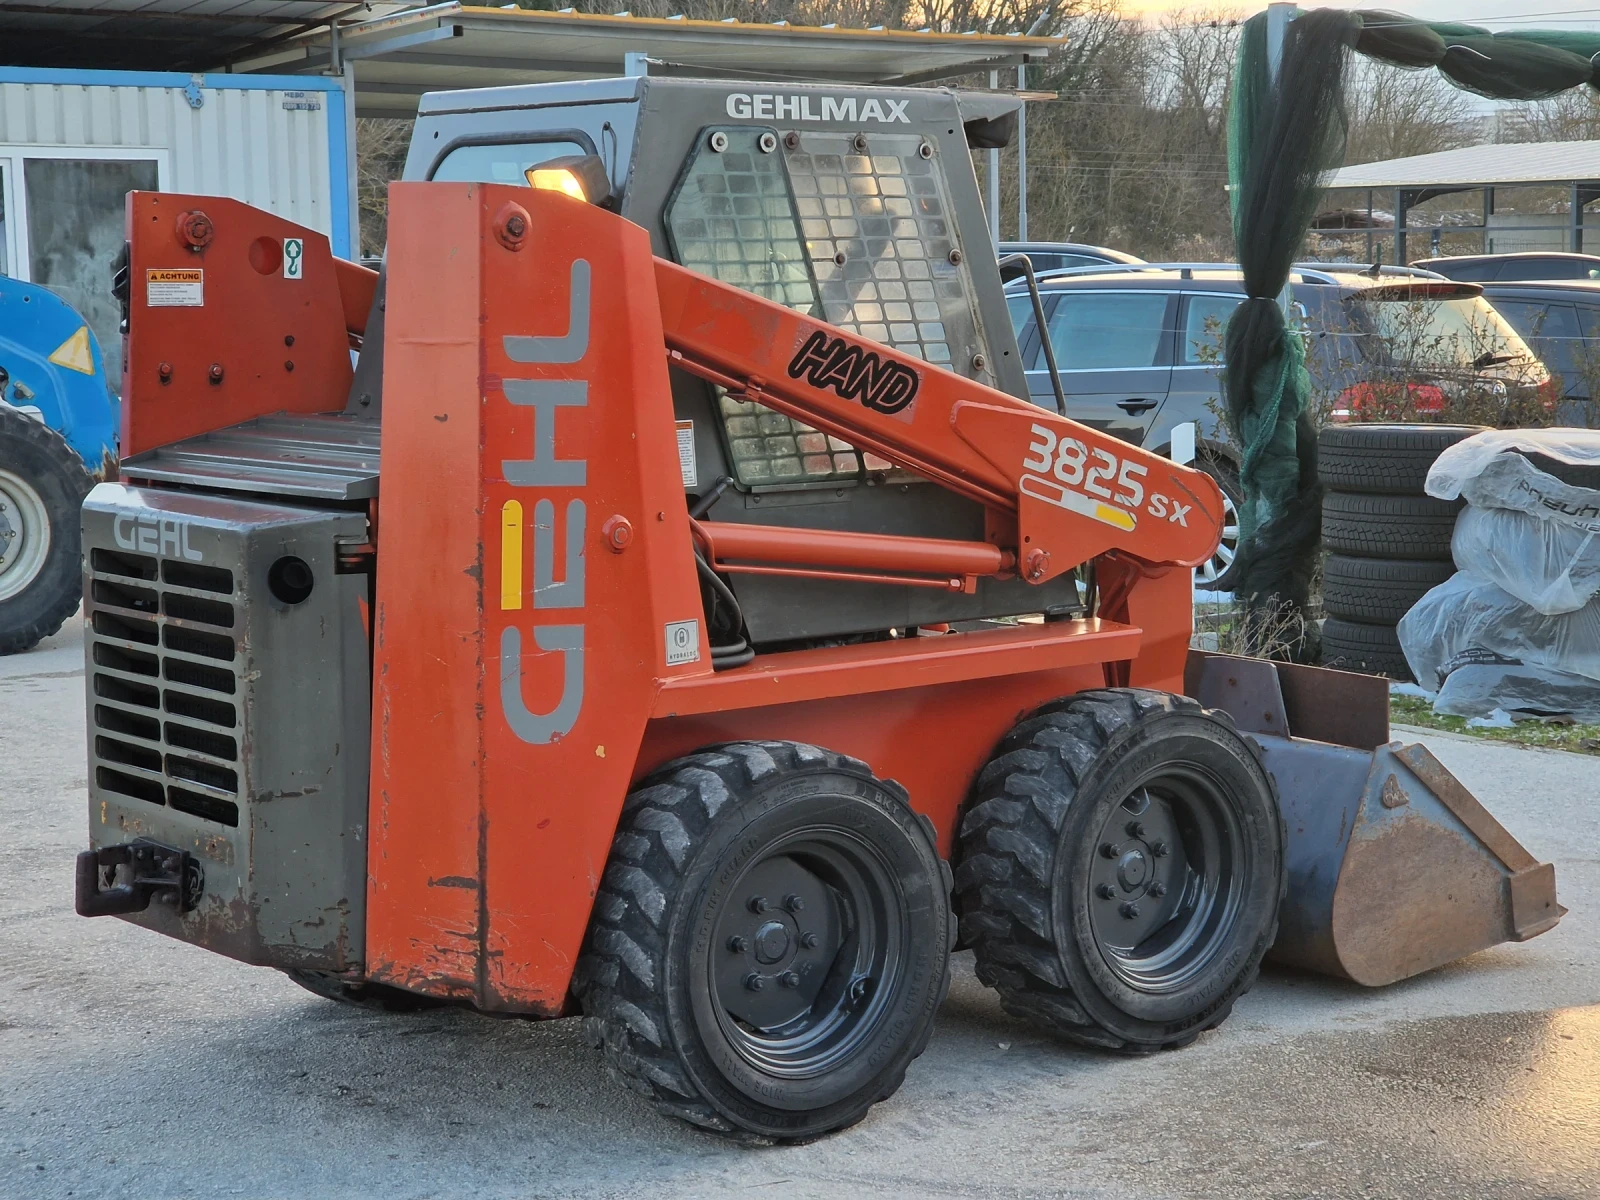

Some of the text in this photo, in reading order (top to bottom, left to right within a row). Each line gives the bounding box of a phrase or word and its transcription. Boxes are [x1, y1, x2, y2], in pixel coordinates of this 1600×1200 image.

[726, 93, 911, 123] GEHLMAX
[788, 330, 919, 414] HAND
[1023, 423, 1192, 528] 3825 SX
[500, 258, 591, 745] GEHL
[113, 511, 203, 561] GEHL
[1107, 740, 1129, 765] BKT
[875, 792, 899, 814] BKT
